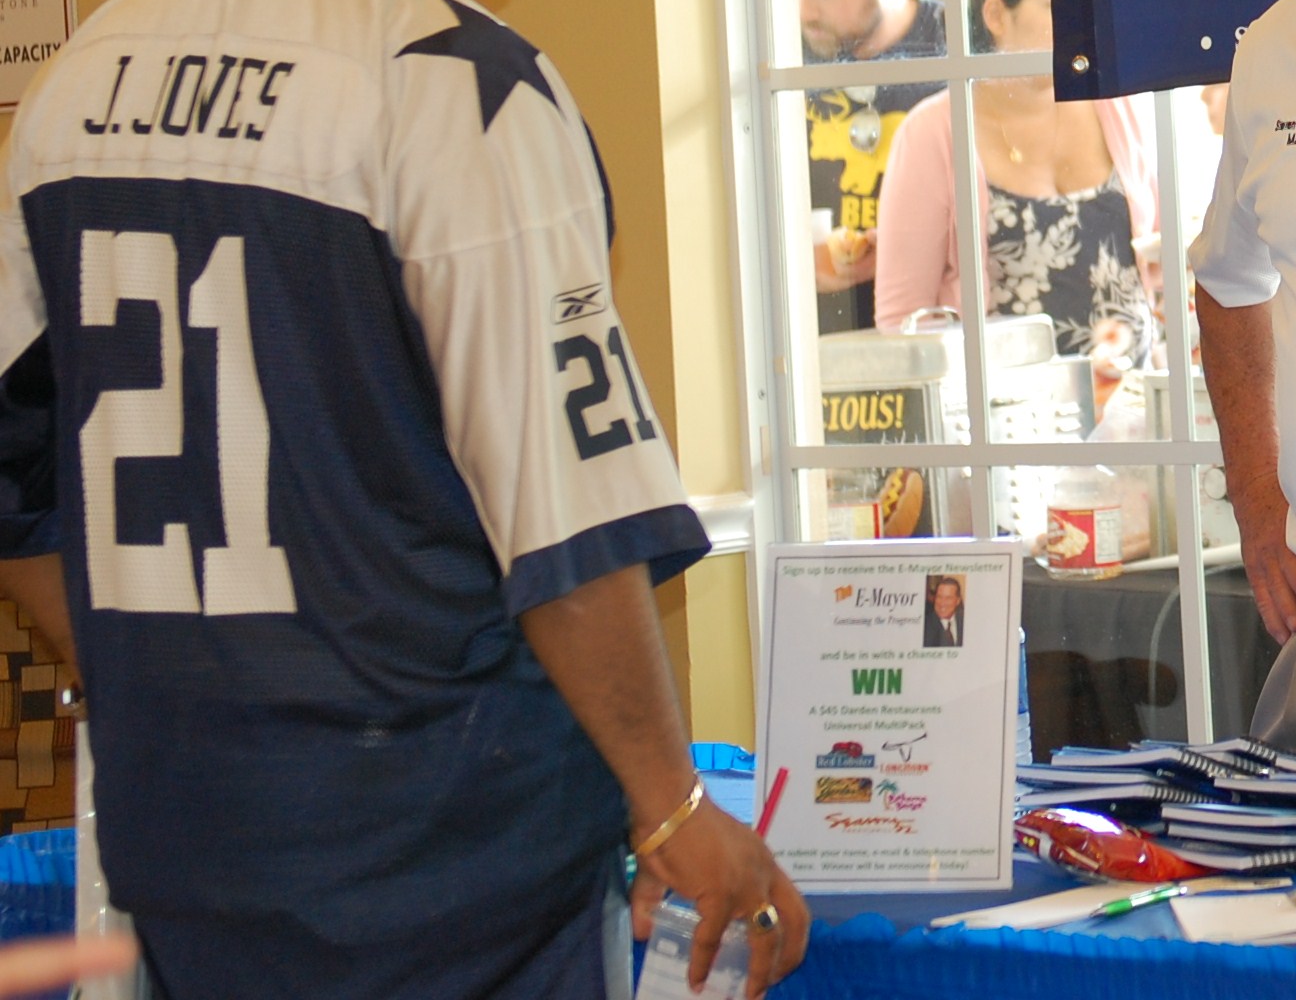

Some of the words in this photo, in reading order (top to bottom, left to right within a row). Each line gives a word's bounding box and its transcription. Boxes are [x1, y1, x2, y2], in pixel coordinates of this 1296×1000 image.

[0, 43, 61, 64] APACITY
[841, 196, 879, 230] BE
[553, 325, 657, 461] 21
[79, 229, 298, 616] 21
[822, 393, 904, 431] IOUS!
[782, 565, 804, 577] Sign
[807, 567, 821, 577] up
[824, 566, 835, 575] to
[838, 565, 874, 575] receive
[877, 564, 895, 574] the
[898, 564, 942, 576] E-Mayor
[944, 563, 1004, 574] Newsletter
[855, 587, 918, 613] E-Mayor
[821, 650, 840, 660] and
[842, 650, 856, 660] be
[859, 650, 869, 660] in
[871, 649, 895, 660] with
[906, 648, 943, 659] chance
[946, 648, 959, 658] to
[852, 668, 903, 695] WIN
[809, 706, 817, 715] A
[840, 705, 879, 715] Darden
[880, 705, 942, 715] Restaurants
[824, 721, 872, 731] Universal
